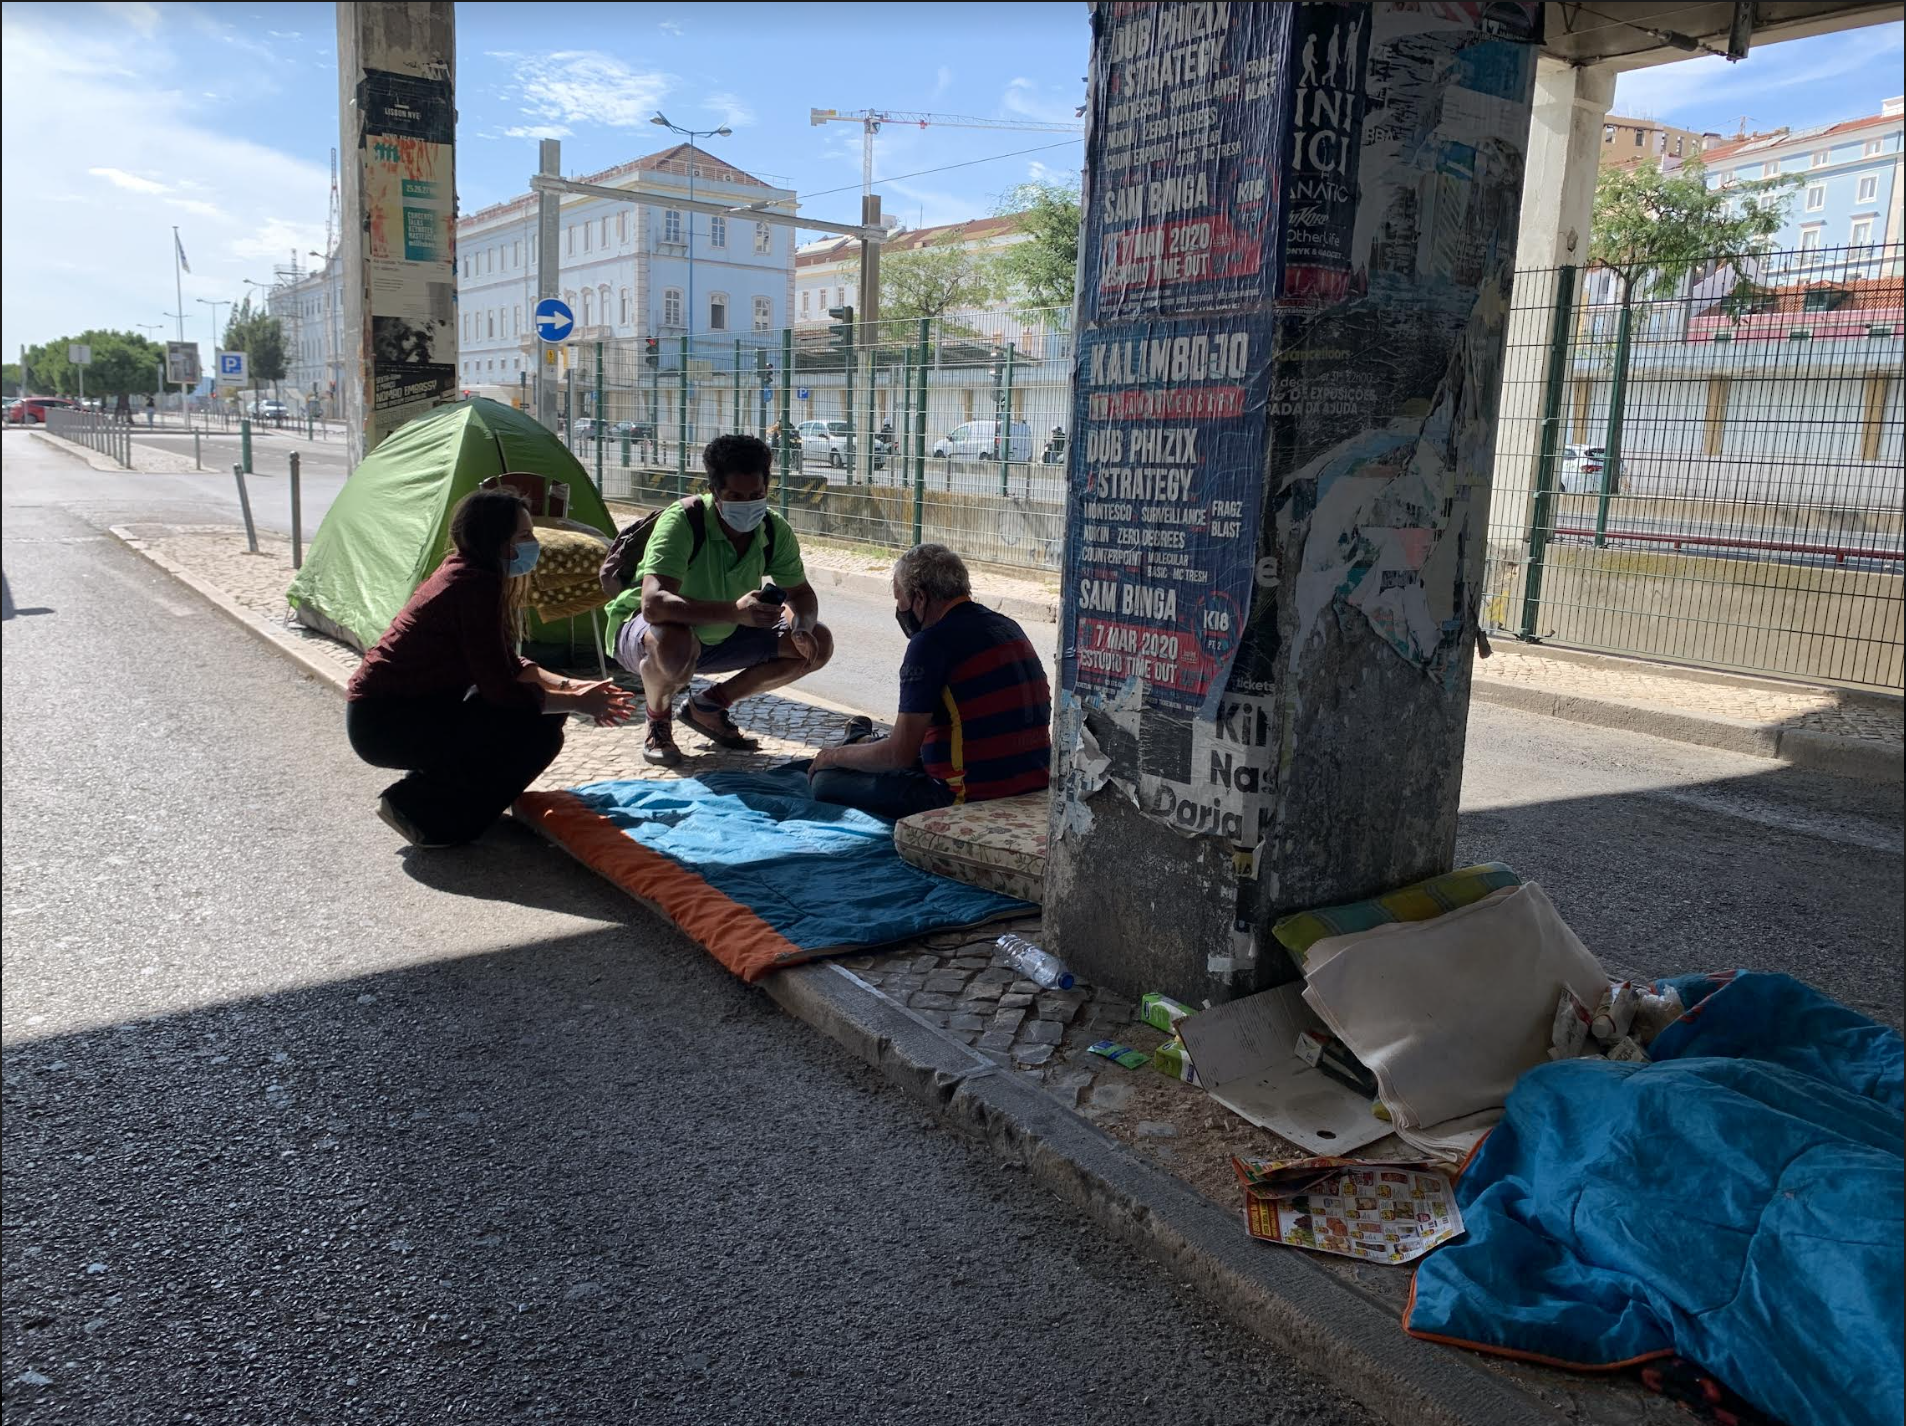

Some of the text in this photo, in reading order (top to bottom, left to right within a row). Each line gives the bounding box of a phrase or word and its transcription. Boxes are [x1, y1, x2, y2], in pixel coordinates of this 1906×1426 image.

[1111, 18, 1151, 63] DUB
[1104, 184, 1143, 225] SAM
[1170, 223, 1211, 255] 2020
[1184, 252, 1209, 277] OUT
[1087, 427, 1198, 464] DUB PHIZIX
[1098, 468, 1195, 502] STRATEGY
[1084, 504, 1207, 527] MONTESCO SURVEILLANCE
[1211, 500, 1243, 518] FRAGZ
[1117, 527, 1141, 546] ZERO
[1142, 529, 1186, 550] DEGREES
[1211, 521, 1242, 539] BLAST
[1255, 556, 1280, 587] e
[1079, 578, 1177, 623] SAM BINGA
[1095, 624, 1105, 648] 7
[1107, 625, 1138, 654] MAR
[1142, 631, 1178, 661] 2020
[1126, 656, 1151, 681] TIME
[1155, 661, 1178, 684] OUT
[1237, 676, 1276, 692] tickets
